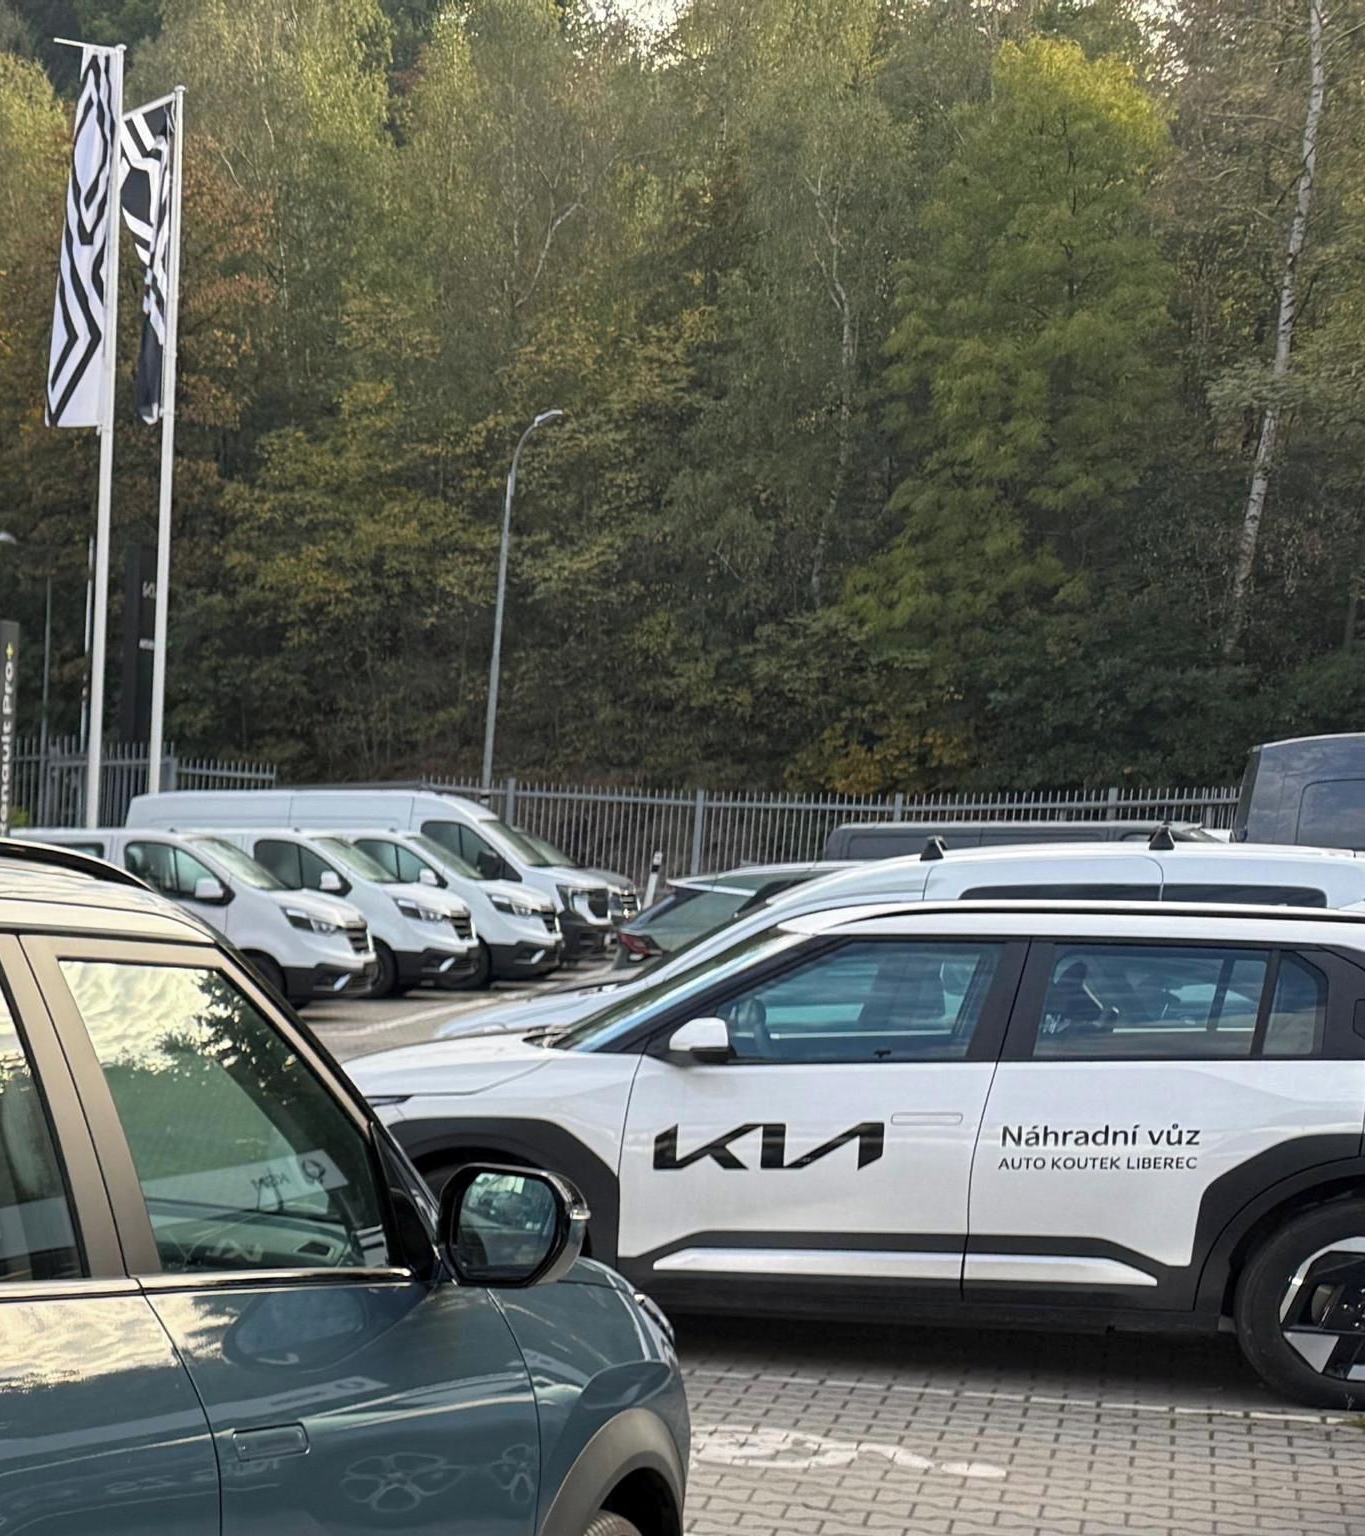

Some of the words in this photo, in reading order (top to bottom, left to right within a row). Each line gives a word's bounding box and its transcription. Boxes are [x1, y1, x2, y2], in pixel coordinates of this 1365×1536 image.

[653, 1122, 884, 1170] KIA
[1000, 1125, 1140, 1147] Náhradní
[1148, 1123, 1201, 1146] vůz
[998, 1157, 1046, 1170] AUTO
[1051, 1157, 1120, 1170] KOUTEK
[1126, 1157, 1198, 1170] LIBEREC
